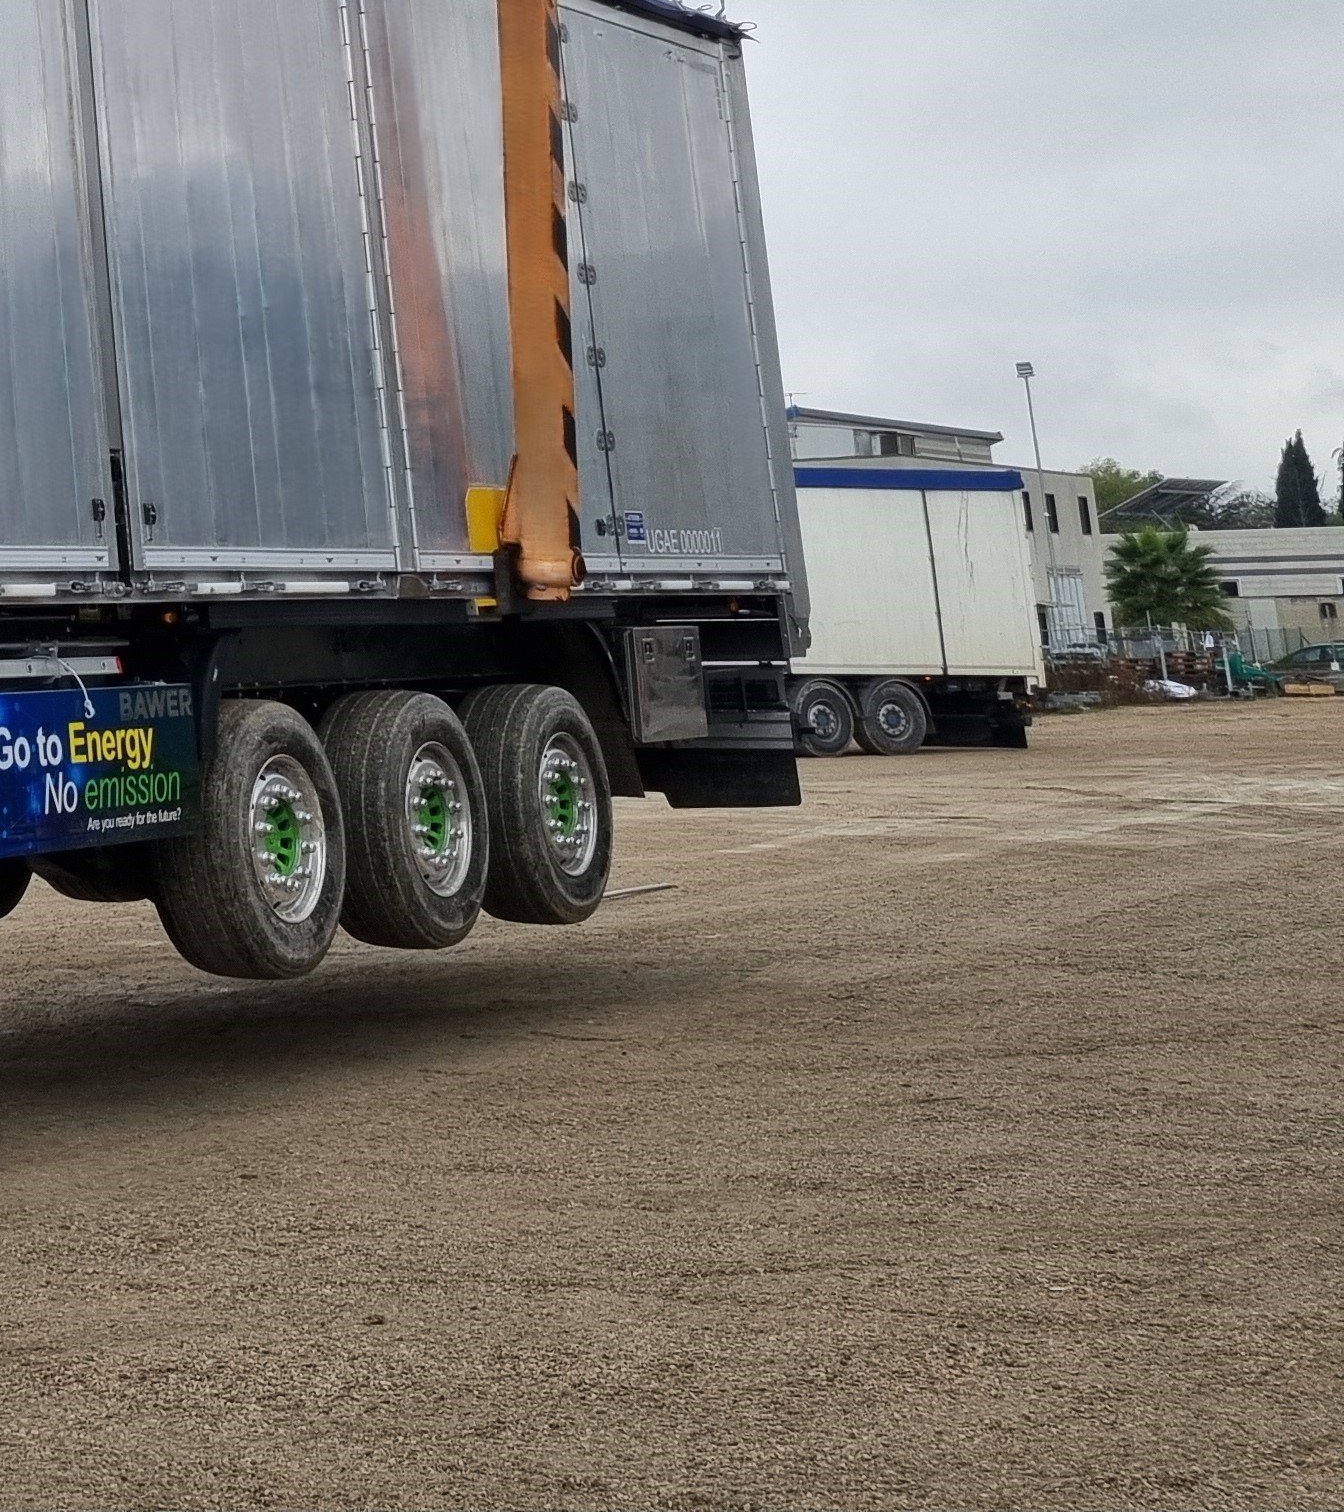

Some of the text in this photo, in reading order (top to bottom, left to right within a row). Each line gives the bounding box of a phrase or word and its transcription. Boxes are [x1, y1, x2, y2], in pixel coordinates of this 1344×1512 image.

[646, 529, 680, 553] UGAE
[119, 689, 193, 722] BAWER
[36, 727, 63, 767] to
[69, 722, 154, 770] Energy
[45, 764, 181, 815] No emission
[87, 817, 100, 831] Are
[101, 818, 114, 833] you
[115, 812, 135, 829] ready
[136, 812, 145, 825] for
[146, 810, 157, 824] the
